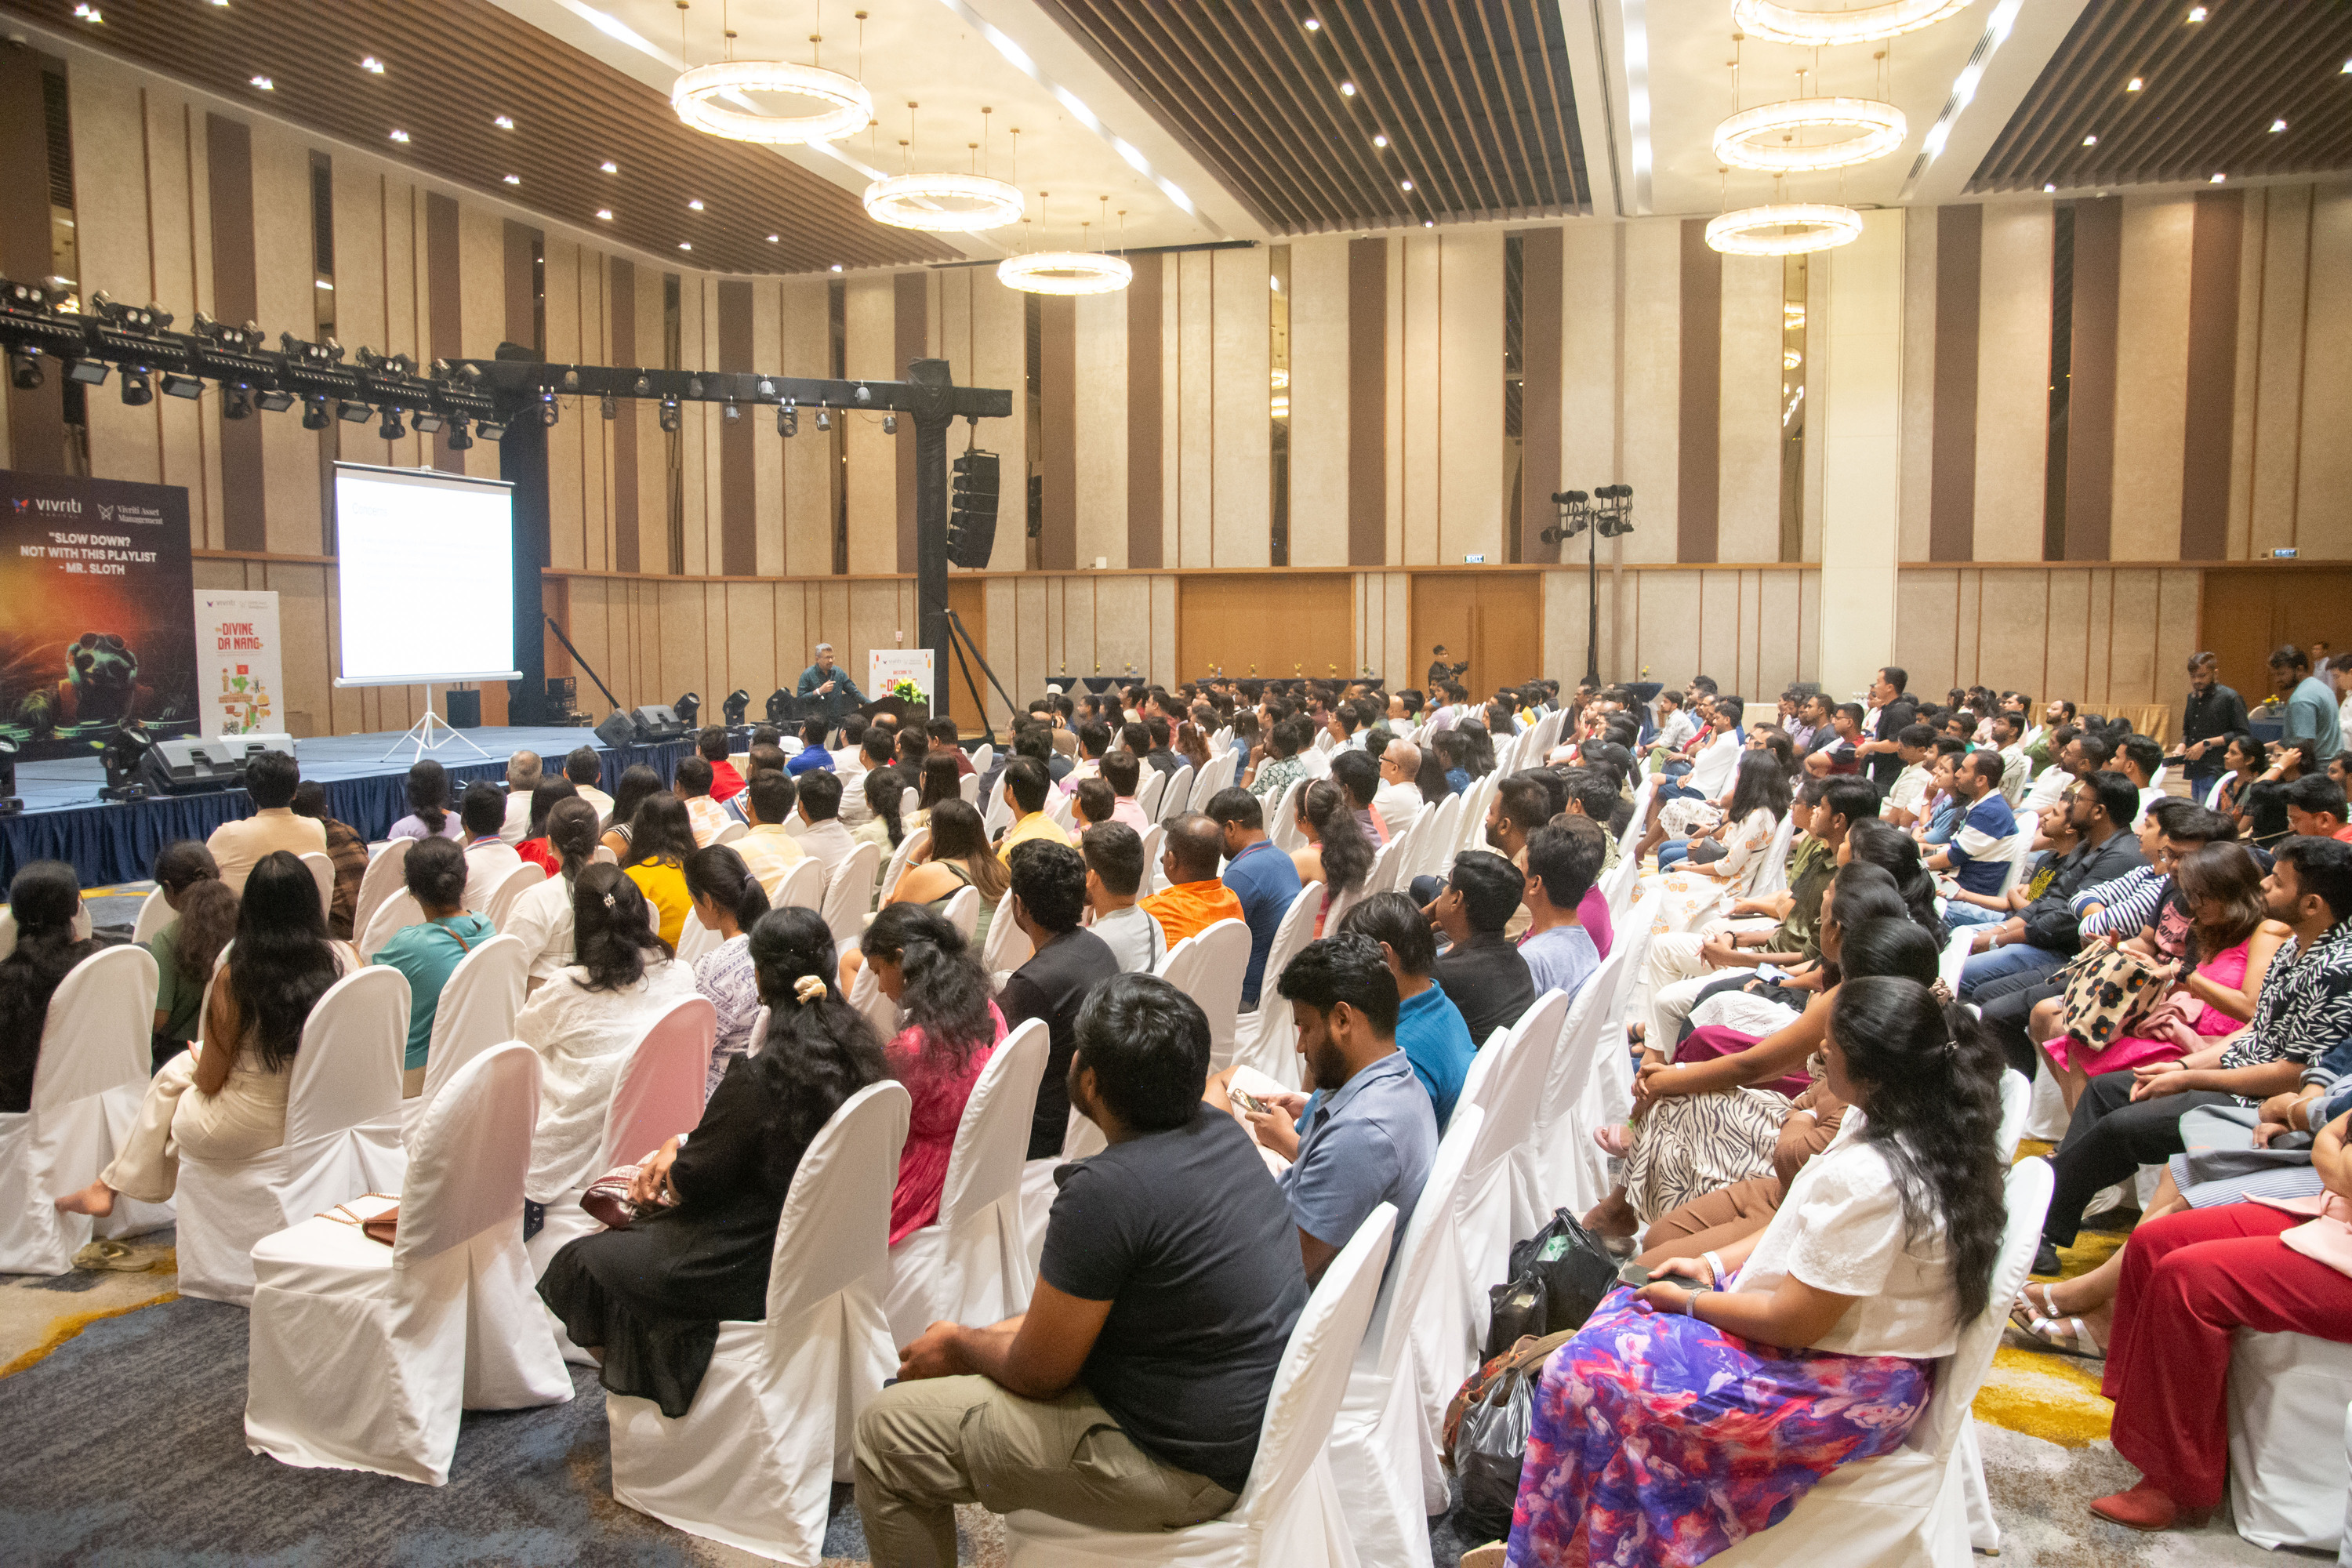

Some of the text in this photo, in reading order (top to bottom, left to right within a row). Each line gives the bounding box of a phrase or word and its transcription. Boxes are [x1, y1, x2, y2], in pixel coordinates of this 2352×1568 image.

[36, 499, 82, 513] vivriti
[49, 532, 131, 546] "SLOW DOWN?
[20, 546, 157, 562] NOT WITH THIS PLAYLIST
[66, 562, 87, 573] MR.
[89, 564, 125, 575] SLOTH
[222, 622, 254, 635] DIVINE
[218, 637, 260, 650] DA NANG
